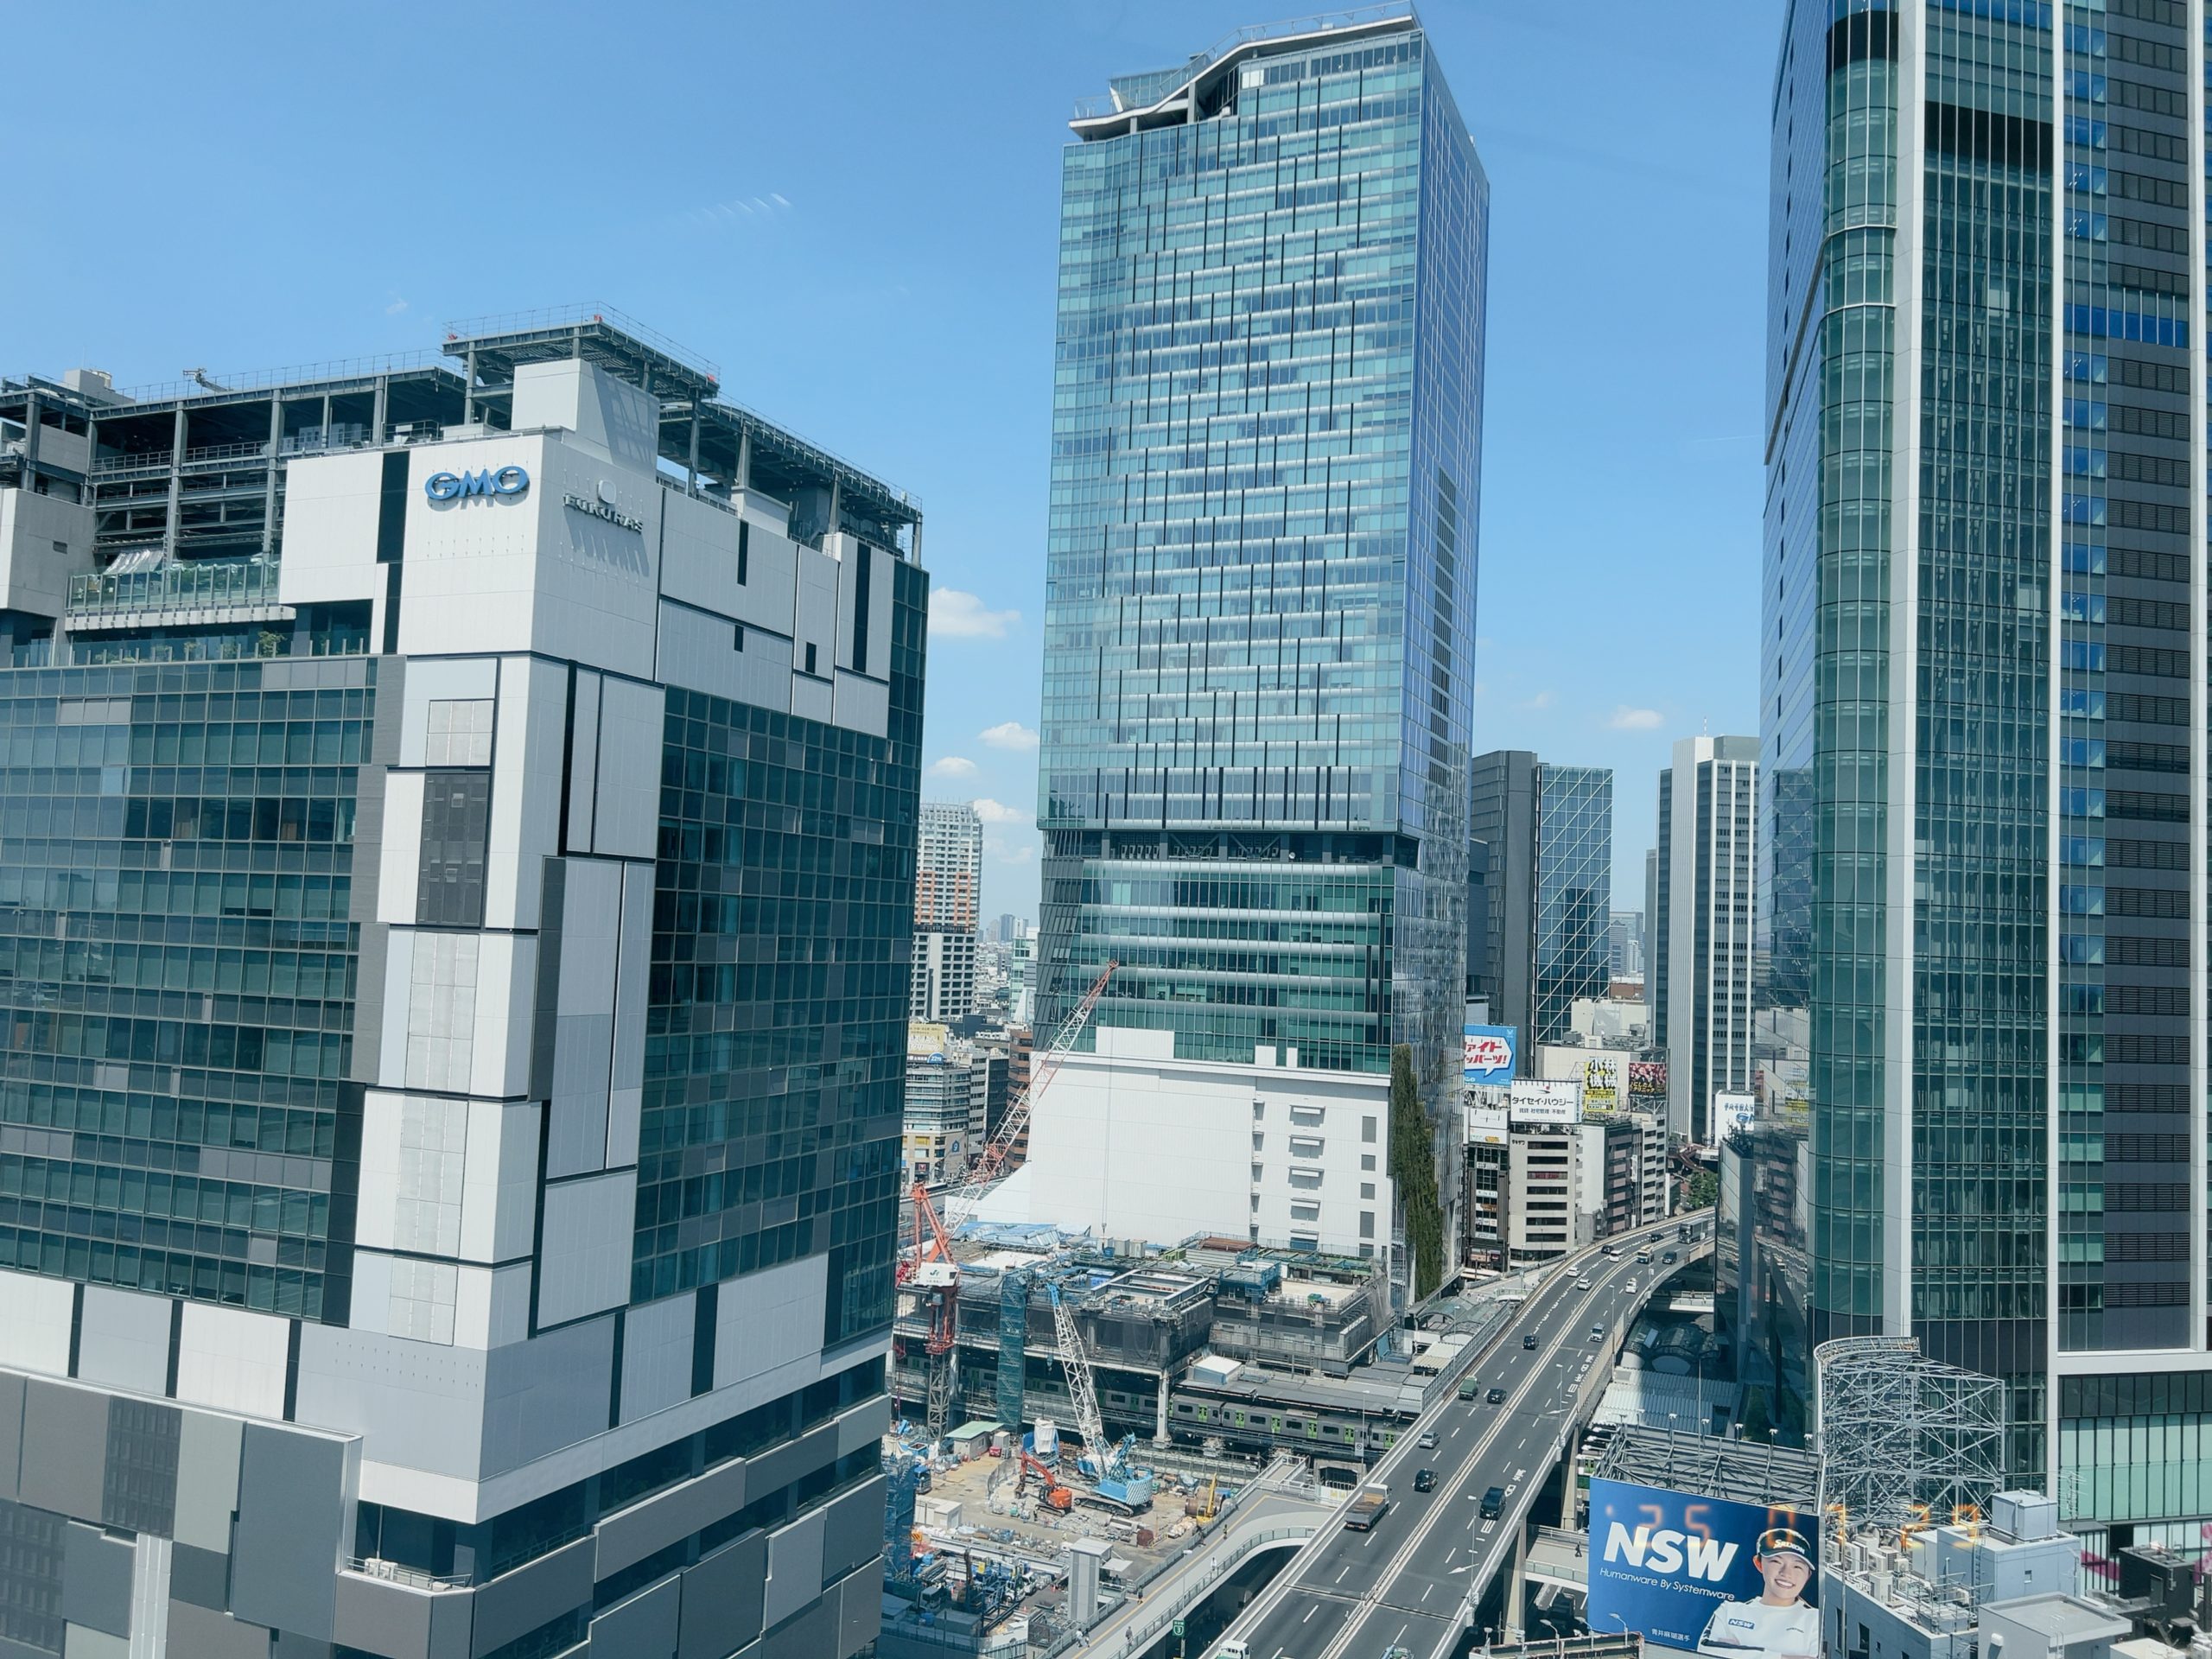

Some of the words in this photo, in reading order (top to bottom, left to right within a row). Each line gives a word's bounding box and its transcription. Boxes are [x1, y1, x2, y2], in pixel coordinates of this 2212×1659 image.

[425, 466, 530, 500] GMO
[563, 493, 644, 533] FUKURAS
[1603, 1521, 1739, 1581] NSW
[1599, 1567, 1658, 1586] Humanware
[1661, 1579, 1672, 1590] By
[1673, 1581, 1735, 1601] Systemware
[1729, 1619, 1754, 1629] NSW
